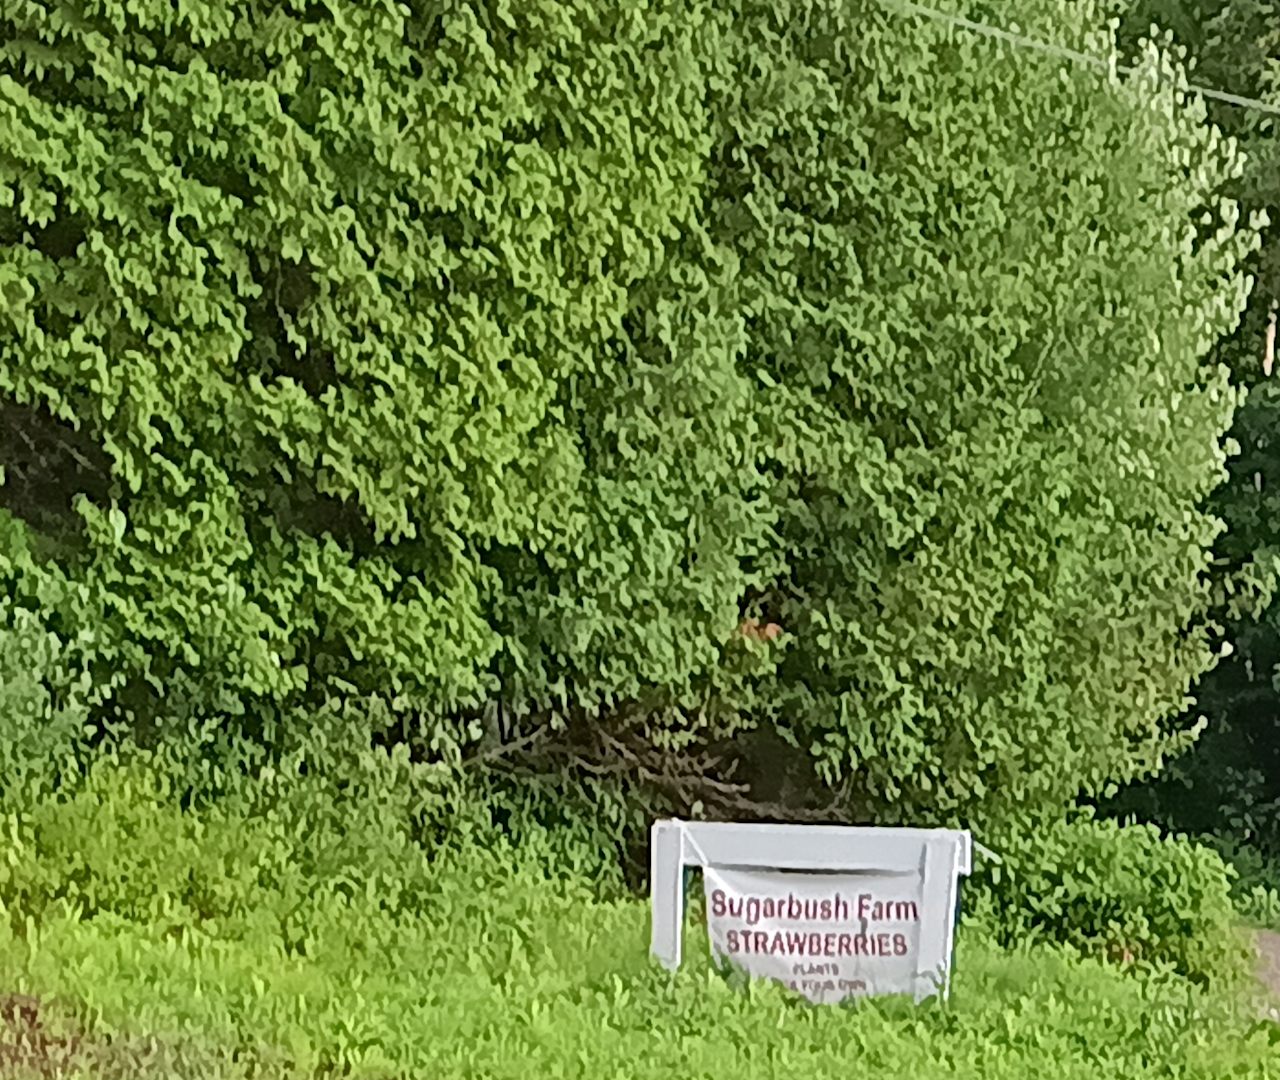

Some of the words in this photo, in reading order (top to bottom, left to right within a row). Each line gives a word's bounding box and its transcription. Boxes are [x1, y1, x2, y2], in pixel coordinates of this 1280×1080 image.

[711, 888, 849, 925] Sugarbush
[857, 893, 920, 922] Farm
[726, 929, 908, 957] STRAWBERRIES
